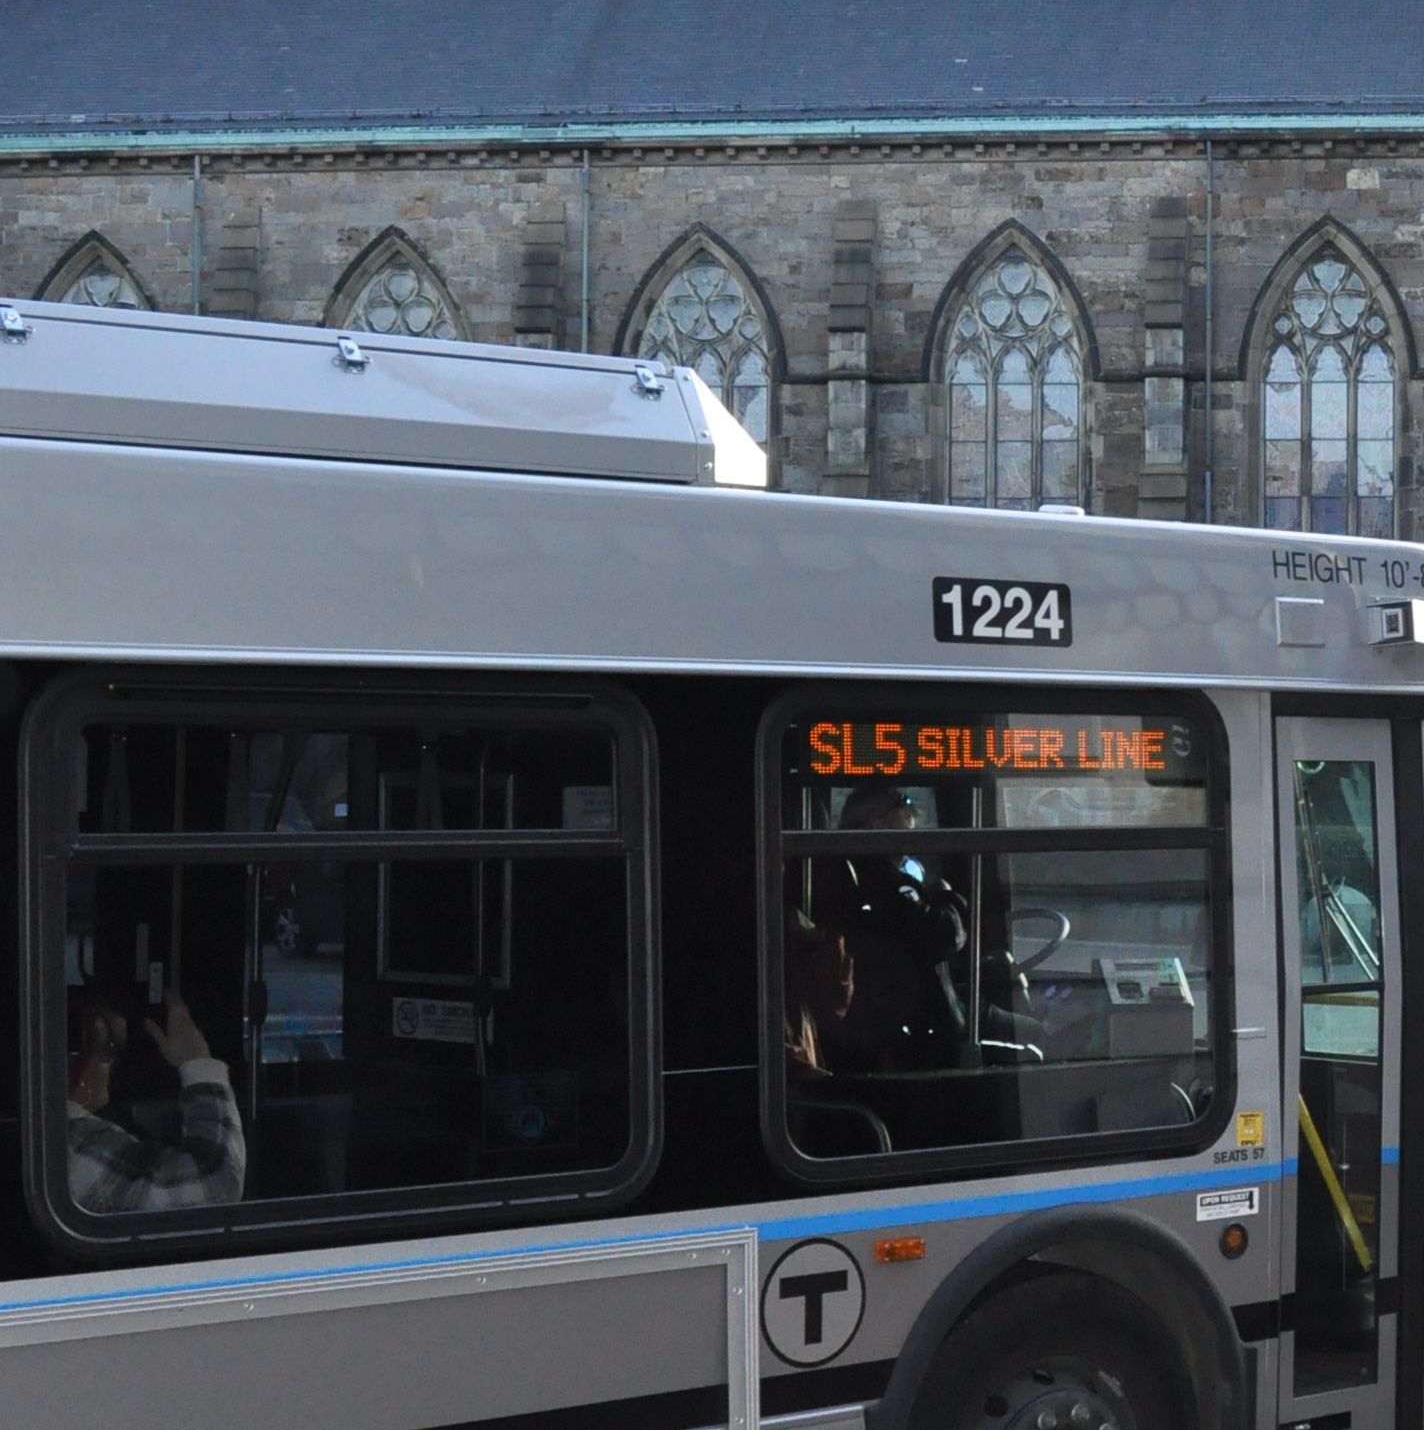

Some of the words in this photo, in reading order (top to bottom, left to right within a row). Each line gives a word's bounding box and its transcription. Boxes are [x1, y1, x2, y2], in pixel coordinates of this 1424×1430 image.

[1271, 550, 1367, 586] HEIGHT
[941, 584, 1065, 640] 1224
[809, 721, 906, 775] SL5
[917, 726, 1065, 769] SILVER
[1077, 729, 1166, 771] LINE
[1213, 1149, 1248, 1164] SEATS
[1253, 1147, 1265, 1160] 57
[779, 1269, 849, 1346] T
